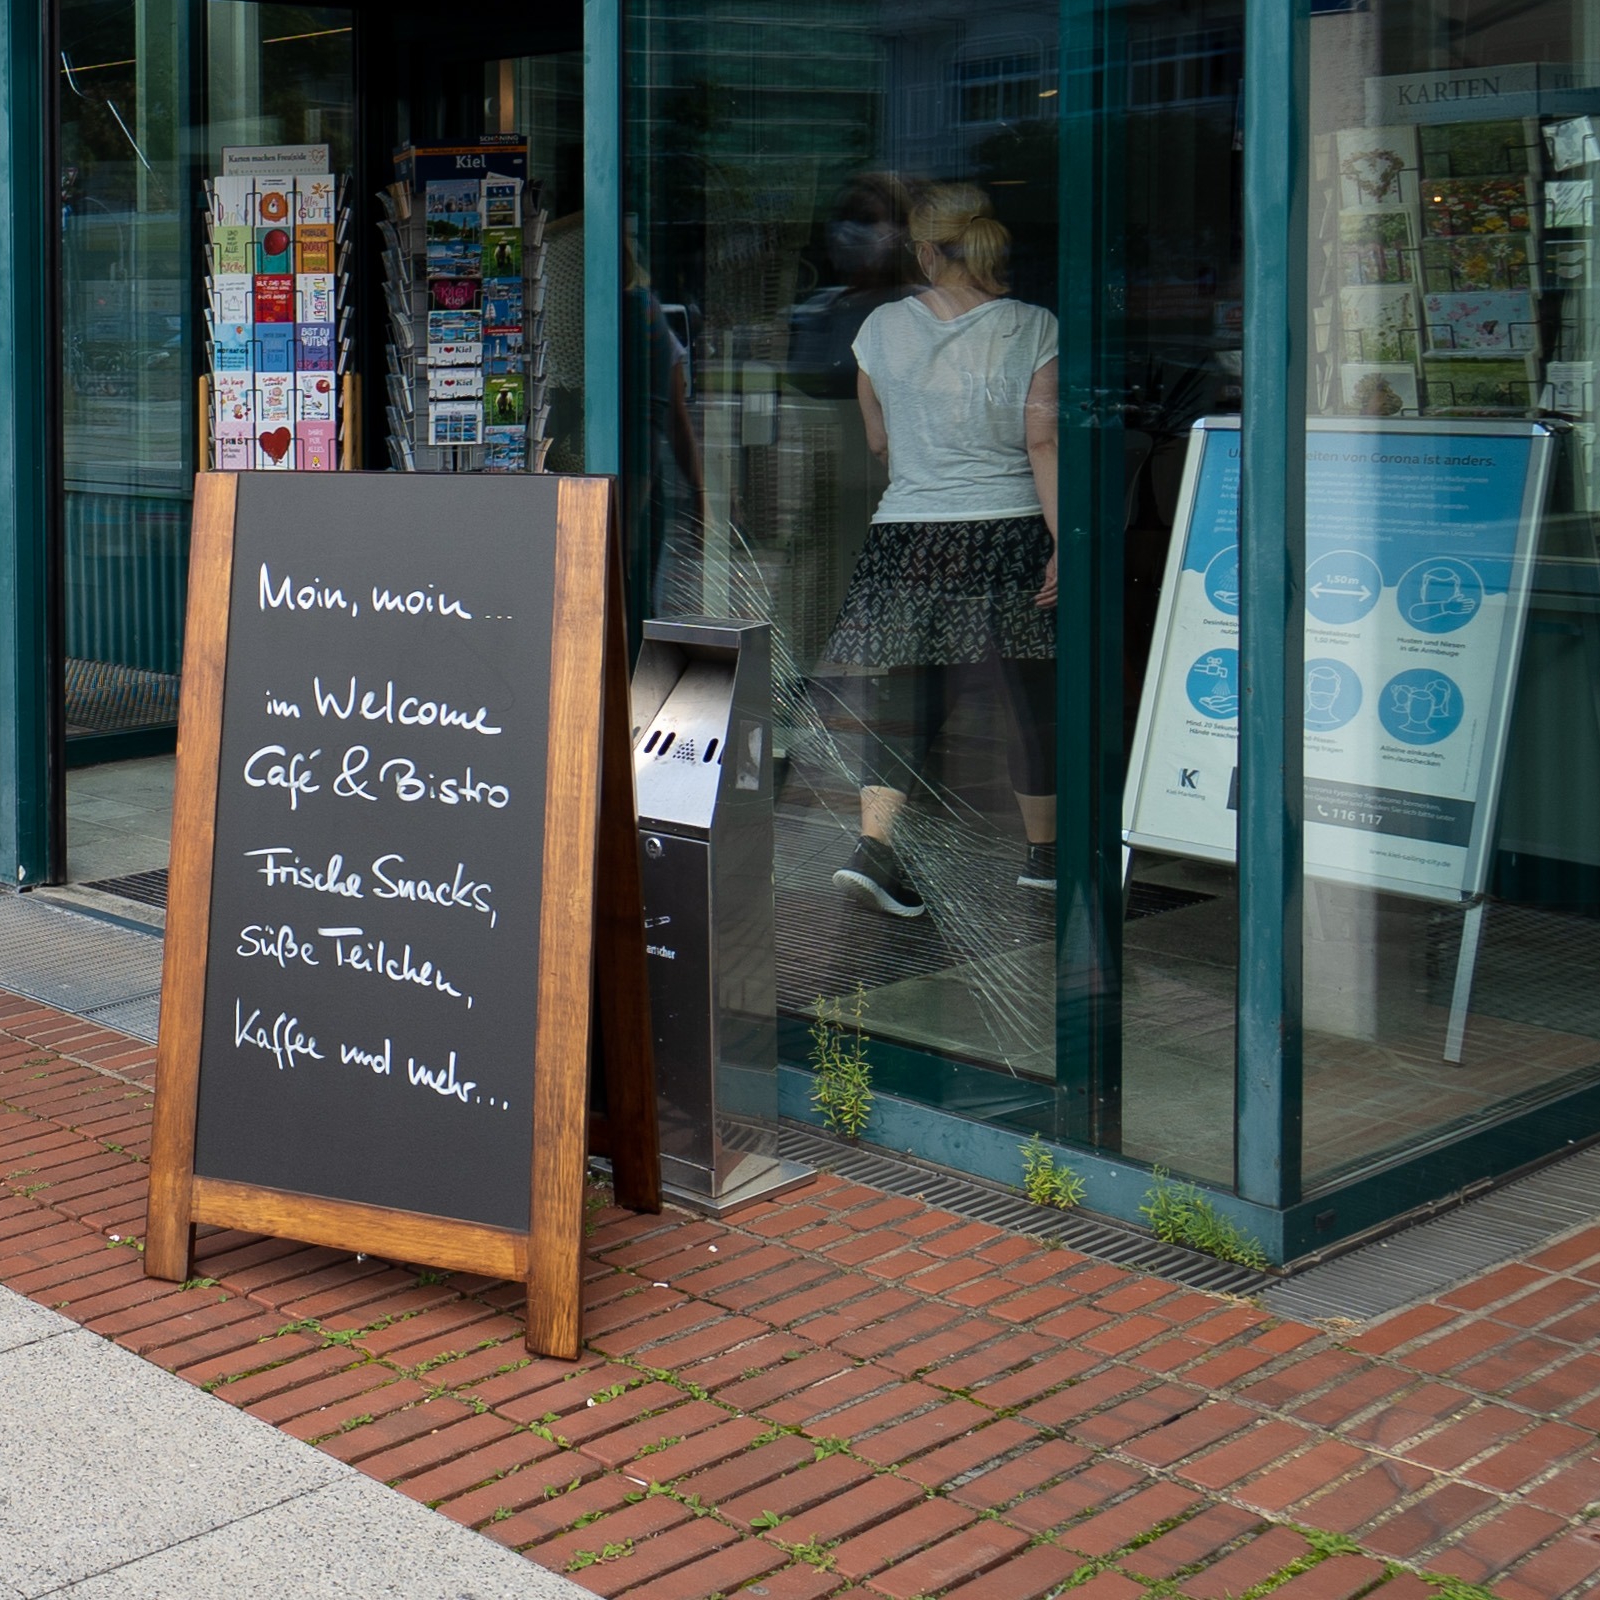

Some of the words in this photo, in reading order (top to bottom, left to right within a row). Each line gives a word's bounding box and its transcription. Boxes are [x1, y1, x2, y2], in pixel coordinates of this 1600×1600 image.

[1397, 77, 1501, 106] KARTEN
[455, 154, 487, 169] Kiel
[455, 345, 473, 354] Kiel
[456, 379, 473, 387] Kiel
[1306, 451, 1340, 463] eiten
[1342, 453, 1367, 463] von
[1370, 452, 1420, 465] Corona
[1423, 452, 1441, 466] ist
[1444, 453, 1497, 467] anders.
[258, 562, 359, 618] Moin,
[1424, 638, 1439, 647] und
[266, 689, 300, 720] im
[313, 677, 502, 736] Welcome
[242, 745, 321, 810] Café
[333, 745, 377, 802] &
[379, 758, 510, 809] Bistro
[1331, 808, 1356, 822] 116
[1359, 812, 1384, 826] 117
[243, 847, 364, 899] Frische
[371, 853, 498, 929] Snacks,
[317, 927, 474, 1009] Teilchen,
[234, 999, 325, 1069] Kaffee
[341, 1038, 392, 1076] und
